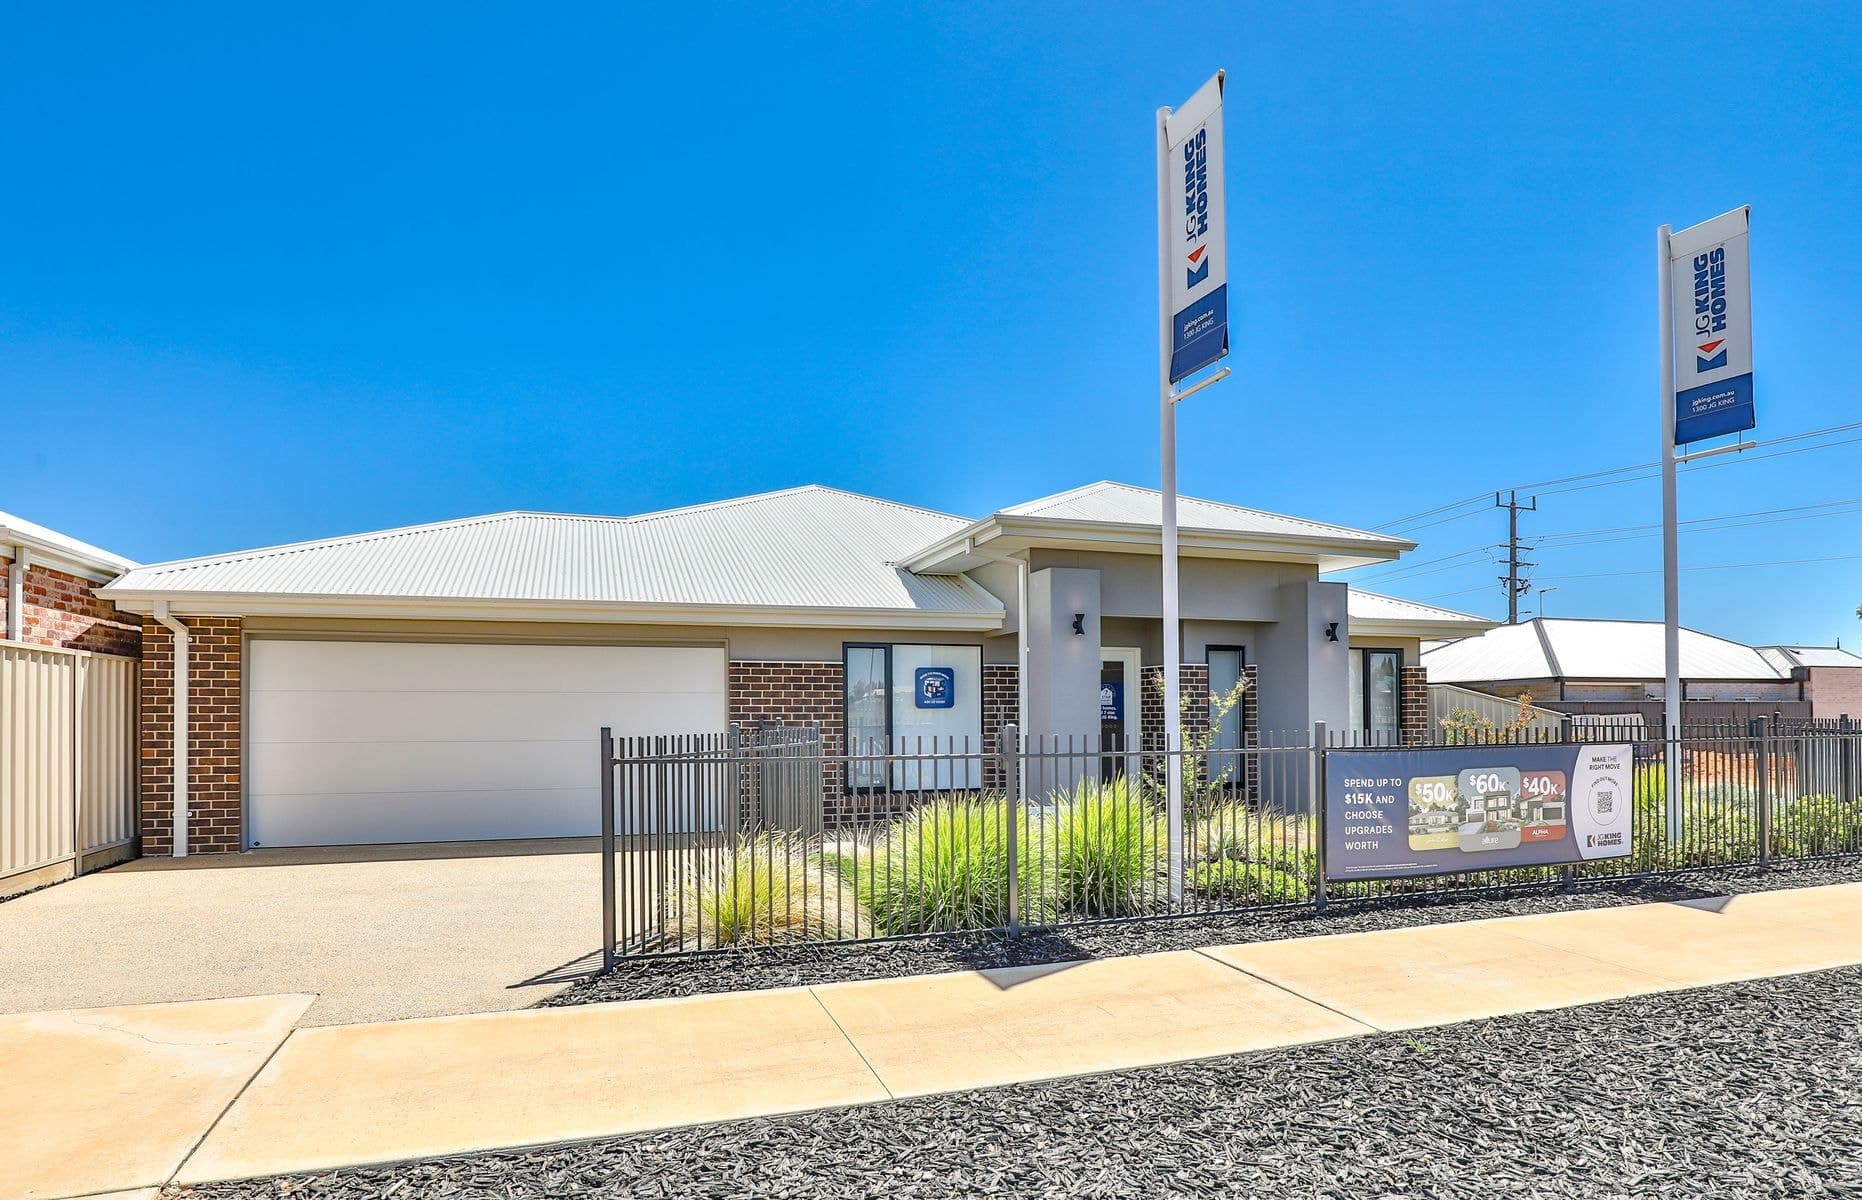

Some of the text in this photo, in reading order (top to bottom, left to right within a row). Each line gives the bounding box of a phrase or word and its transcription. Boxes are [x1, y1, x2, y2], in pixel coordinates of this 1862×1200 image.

[1195, 128, 1208, 237] HOMES
[1709, 247, 1726, 333] HOMES
[1183, 309, 1214, 333] jgking.com.au
[1183, 328, 1195, 340] 1300
[1201, 317, 1214, 329] KING
[1692, 390, 1735, 407] jgking.com.au
[1692, 396, 1735, 413] 1300 JG KING
[1344, 778, 1402, 788] SPEND UP TO
[1344, 793, 1395, 805] $15K AND
[1345, 810, 1384, 820] CHOOSE
[1345, 825, 1393, 835] UPGRADES
[1345, 841, 1379, 850] WORTH
[1597, 838, 1622, 847] HOMES
